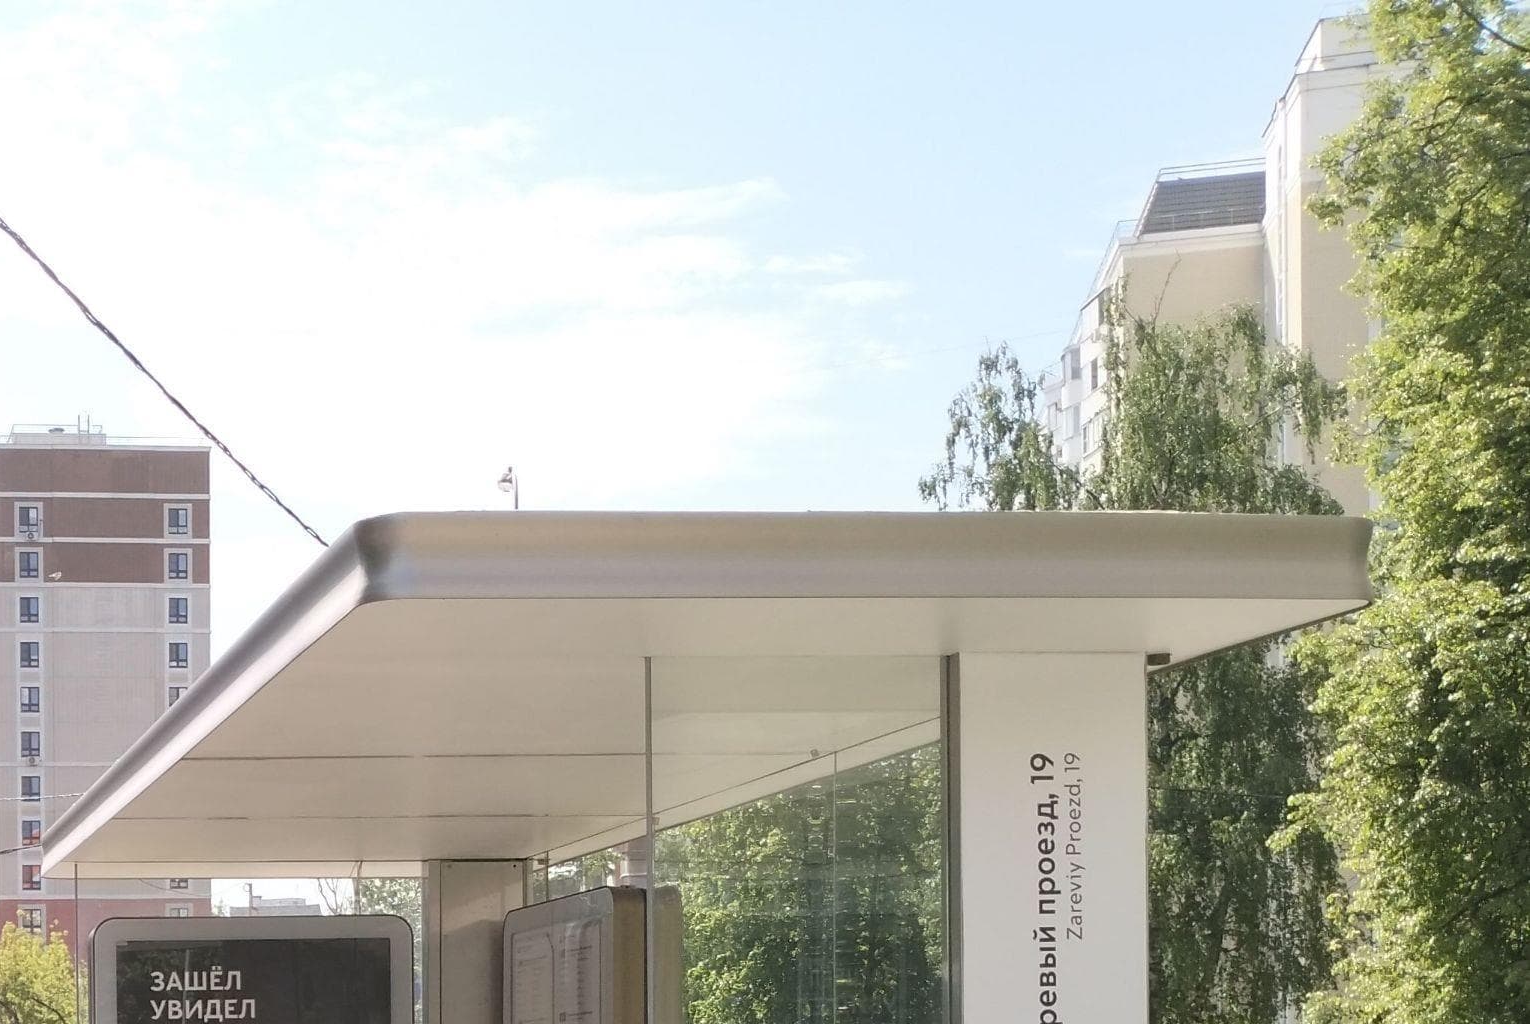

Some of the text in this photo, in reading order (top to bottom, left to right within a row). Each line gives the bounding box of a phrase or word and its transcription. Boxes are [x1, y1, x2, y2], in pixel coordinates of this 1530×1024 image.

[1029, 753, 1055, 785] 19
[1037, 793, 1062, 915] проезд,
[1064, 752, 1087, 940] Zareviy Proezd, 19
[150, 965, 241, 991] ЗАШЁЛ
[150, 998, 256, 1022] УВИДЕЛ
